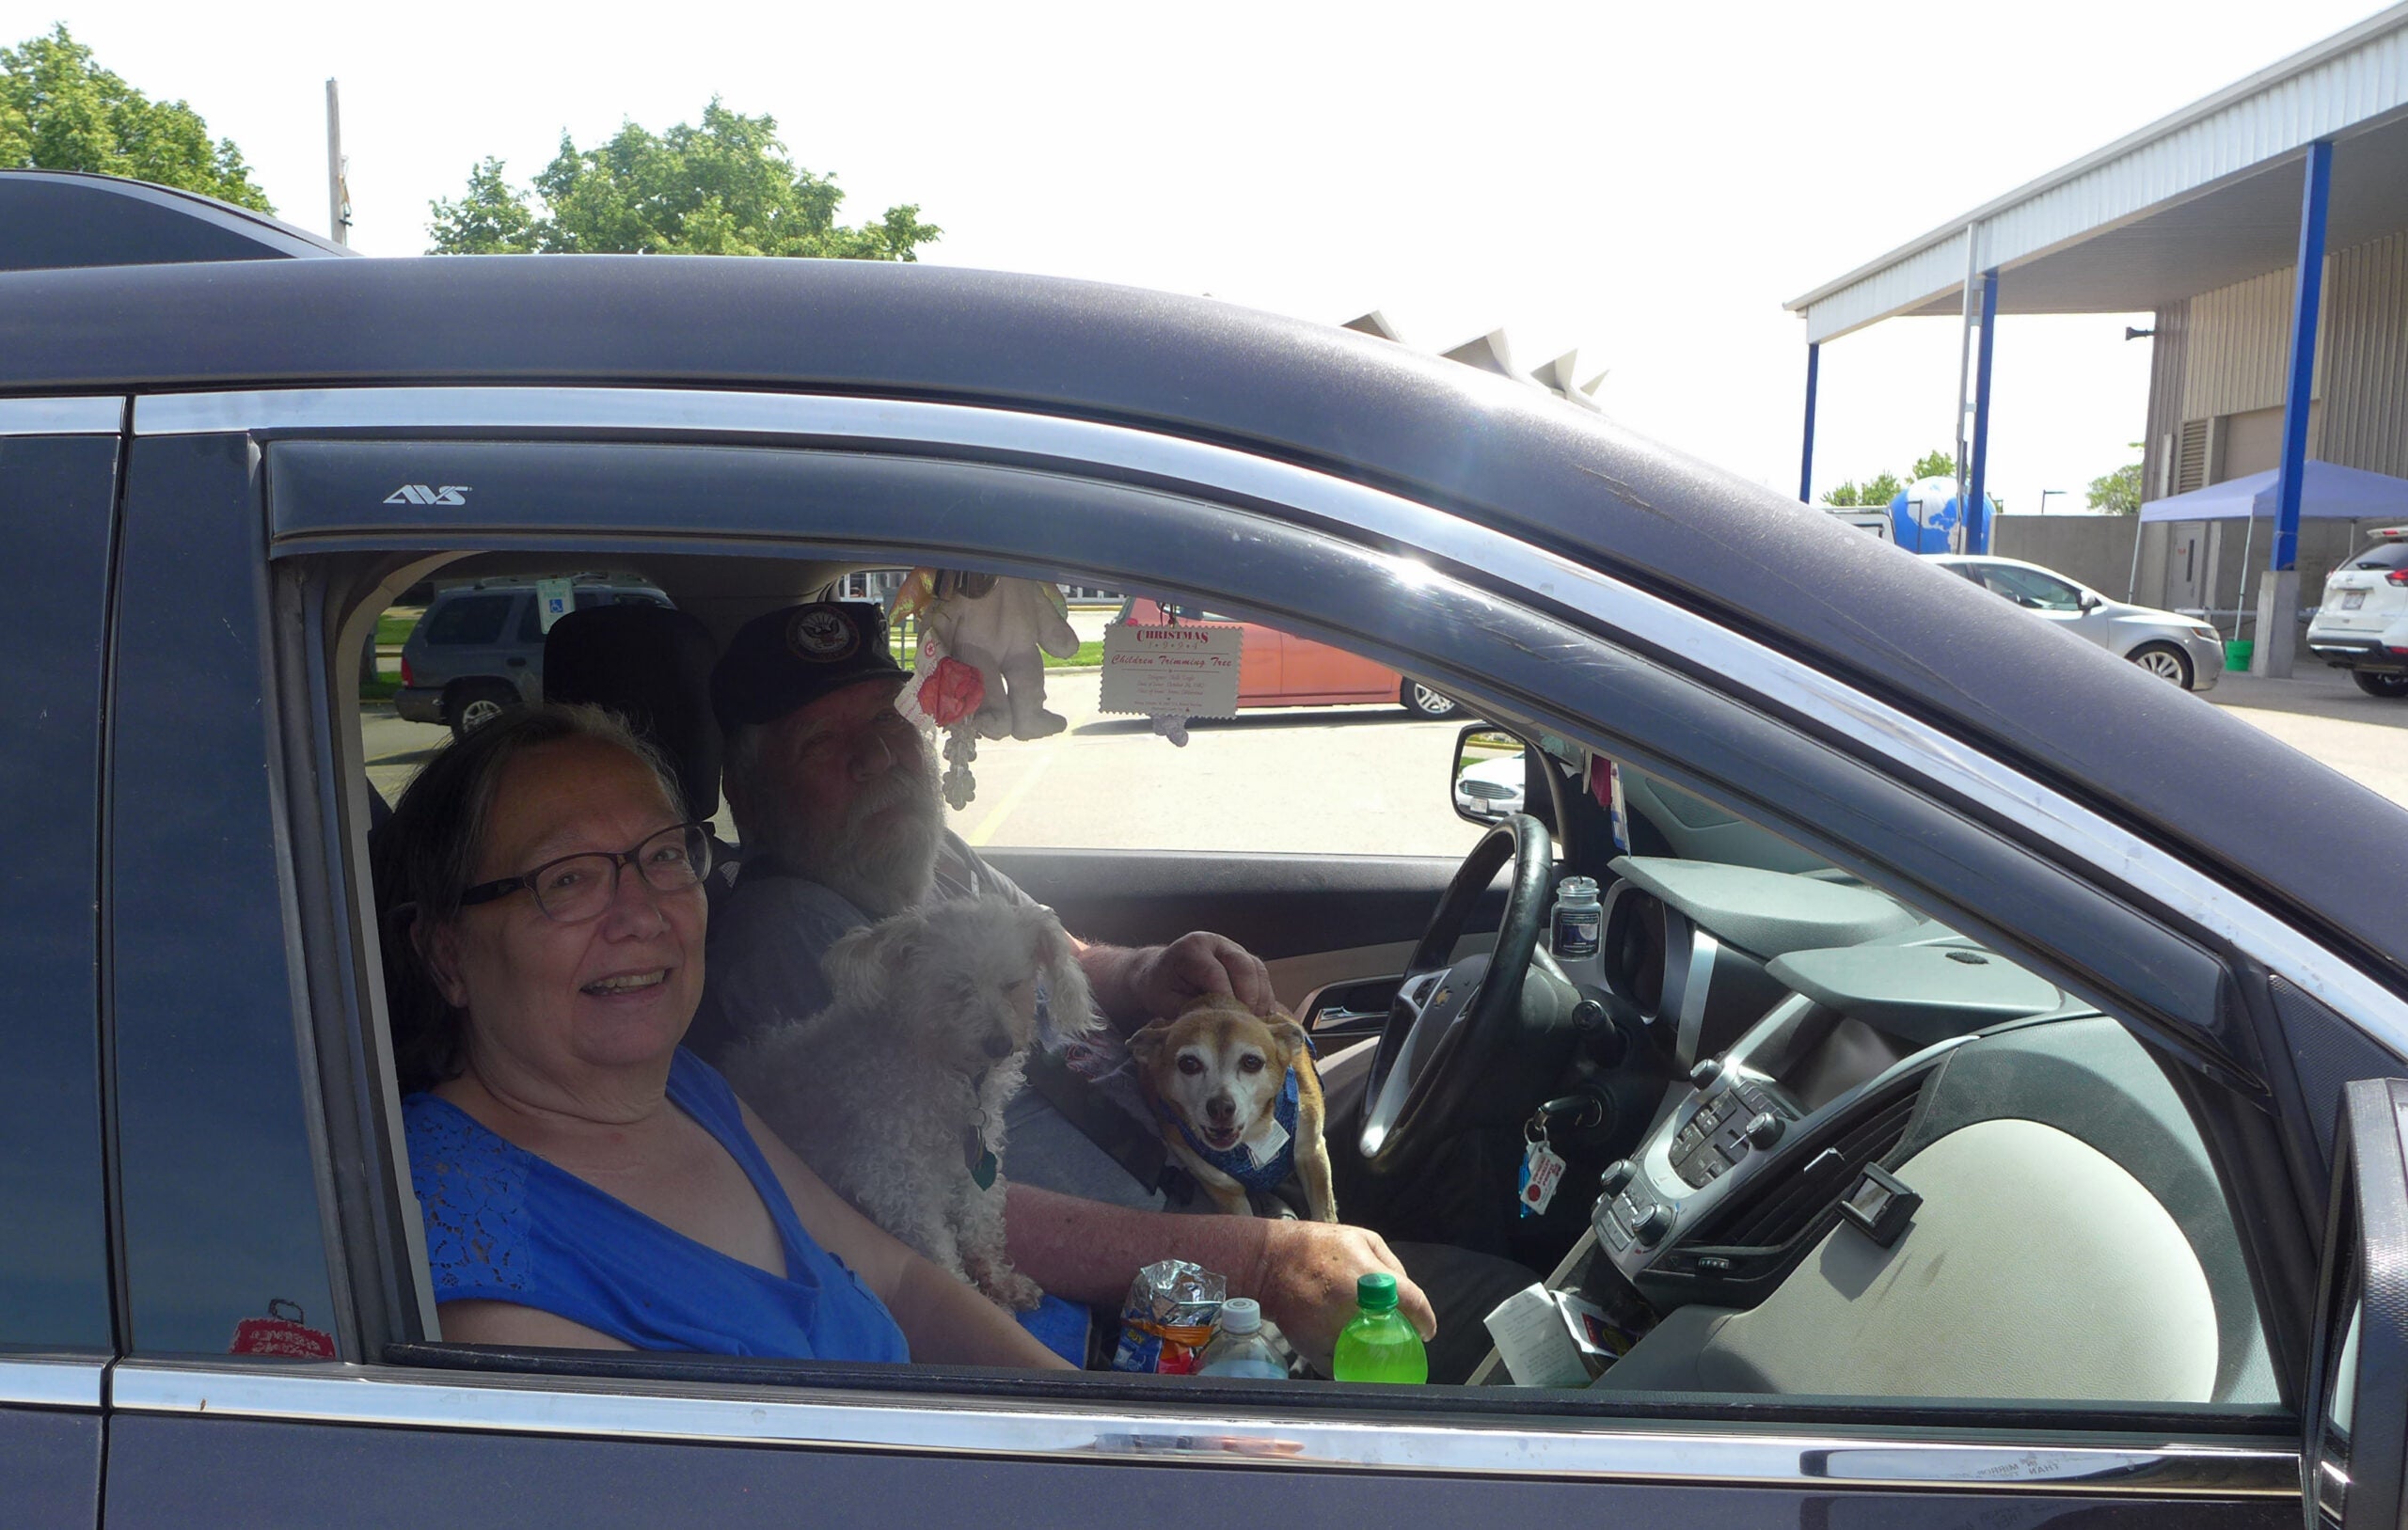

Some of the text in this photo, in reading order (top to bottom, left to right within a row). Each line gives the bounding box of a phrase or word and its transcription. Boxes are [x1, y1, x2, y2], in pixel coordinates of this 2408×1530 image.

[383, 485, 469, 506] AVS
[1136, 630, 1209, 643] CHRISTMAS
[1111, 654, 1232, 669] Children Trimming Tree
